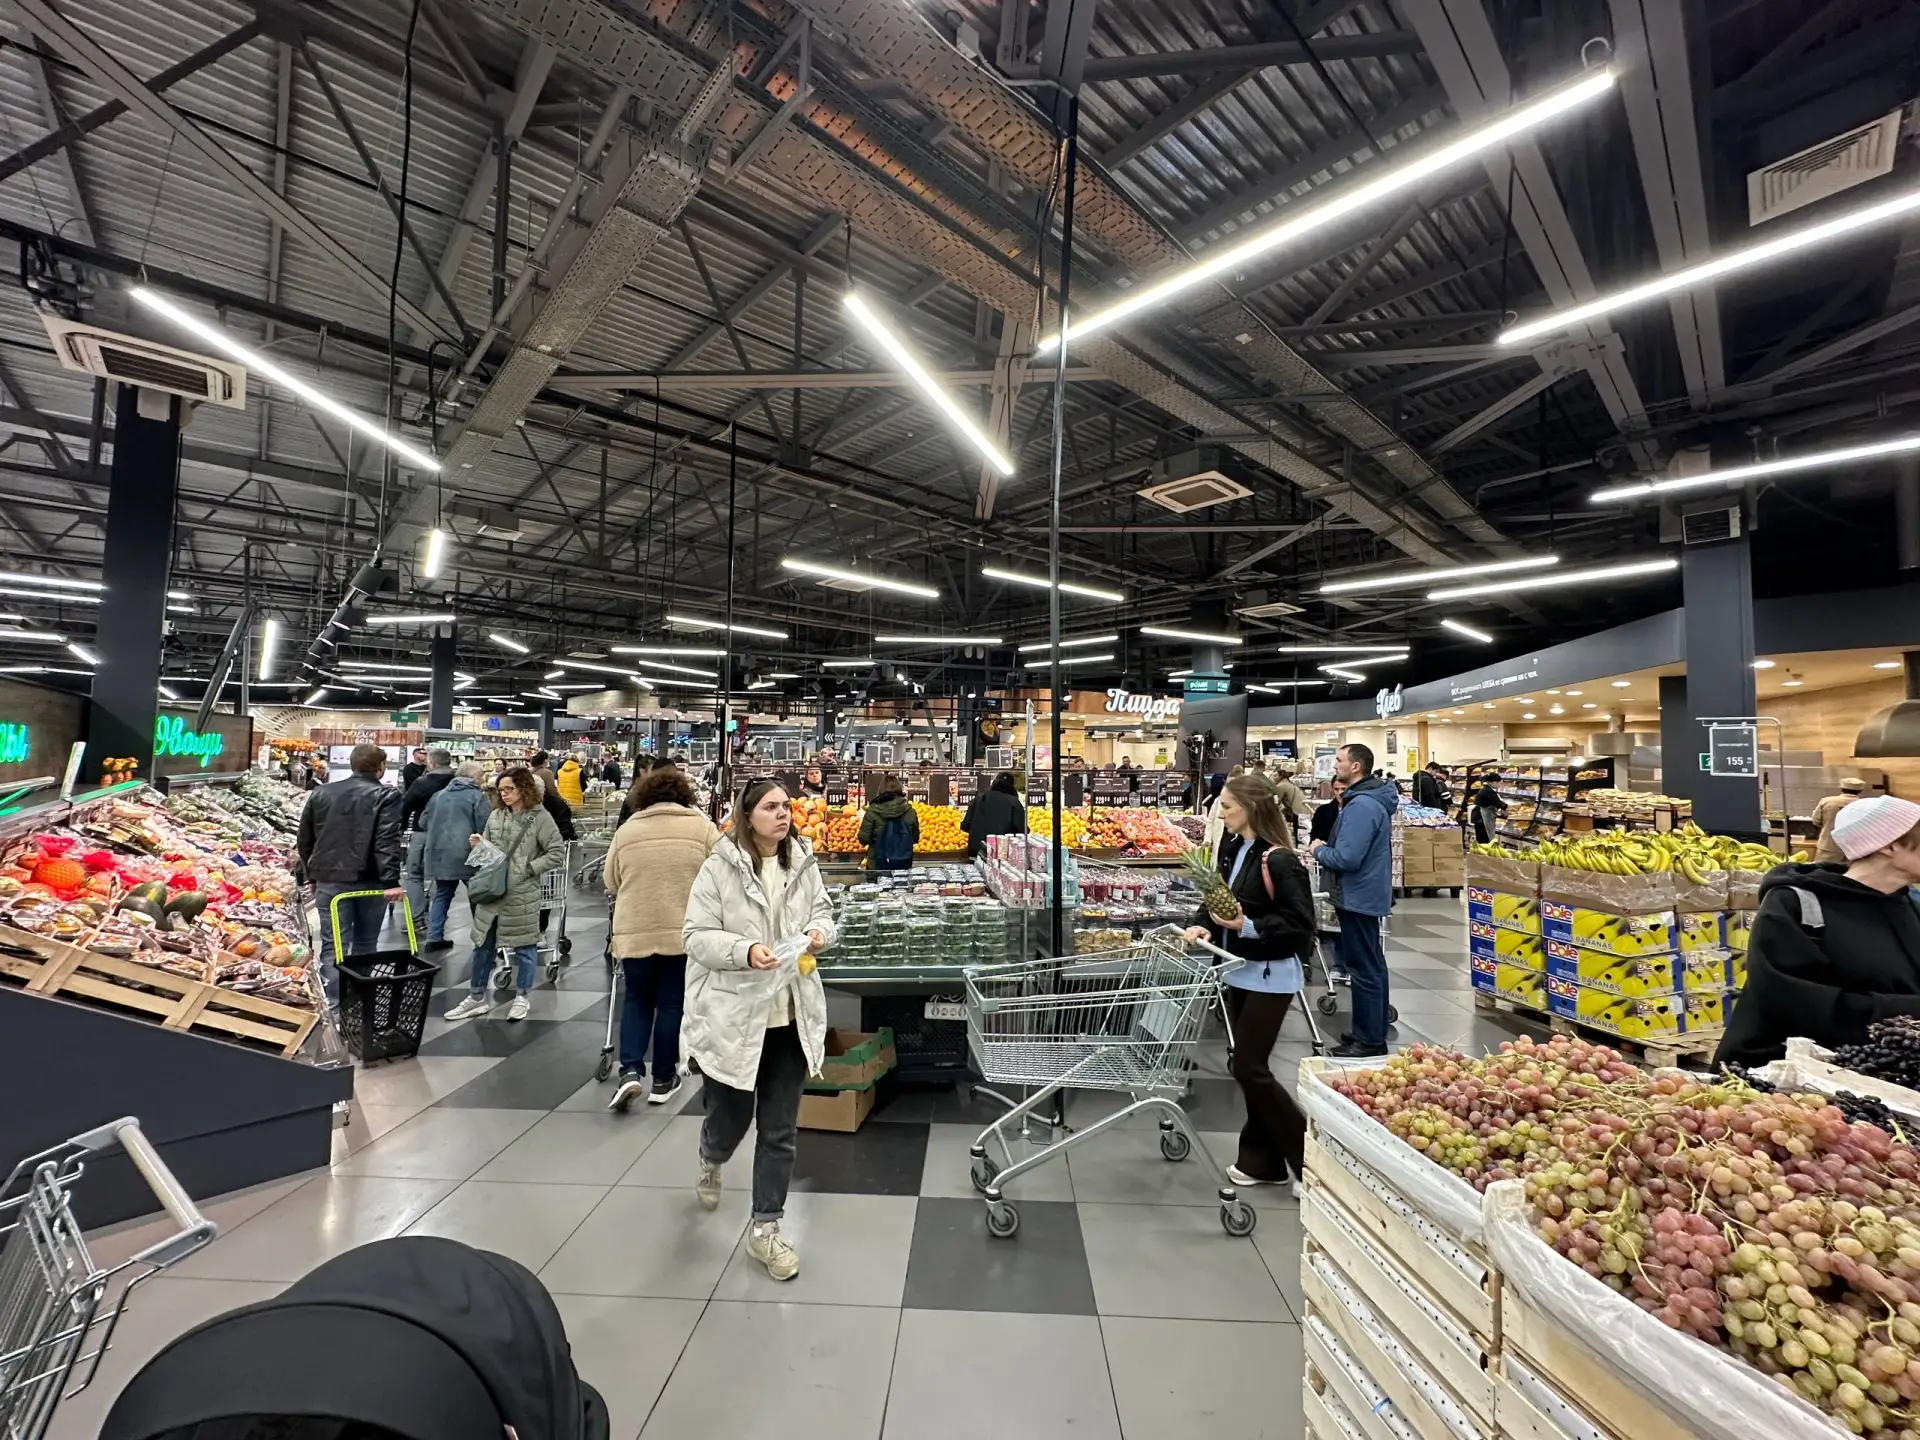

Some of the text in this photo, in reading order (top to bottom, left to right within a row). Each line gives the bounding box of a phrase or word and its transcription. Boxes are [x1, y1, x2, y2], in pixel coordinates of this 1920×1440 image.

[1106, 688, 1181, 722] Пицца
[1376, 683, 1403, 720] Хлеб
[1726, 756, 1743, 765] 155
[1470, 888, 1493, 904] Dole
[1544, 903, 1573, 921] Dole
[1471, 921, 1495, 939] Dole
[1495, 918, 1525, 929] BANANAS
[1549, 940, 1578, 959] Dole
[1576, 936, 1612, 949] BANANAS
[1472, 955, 1496, 973] Dole
[1497, 953, 1528, 966] BANANAS
[1549, 977, 1578, 997] Dole
[1582, 976, 1620, 991] BANANAS
[1498, 988, 1528, 1002] BANANAS
[1580, 1013, 1619, 1030] BANANAS
